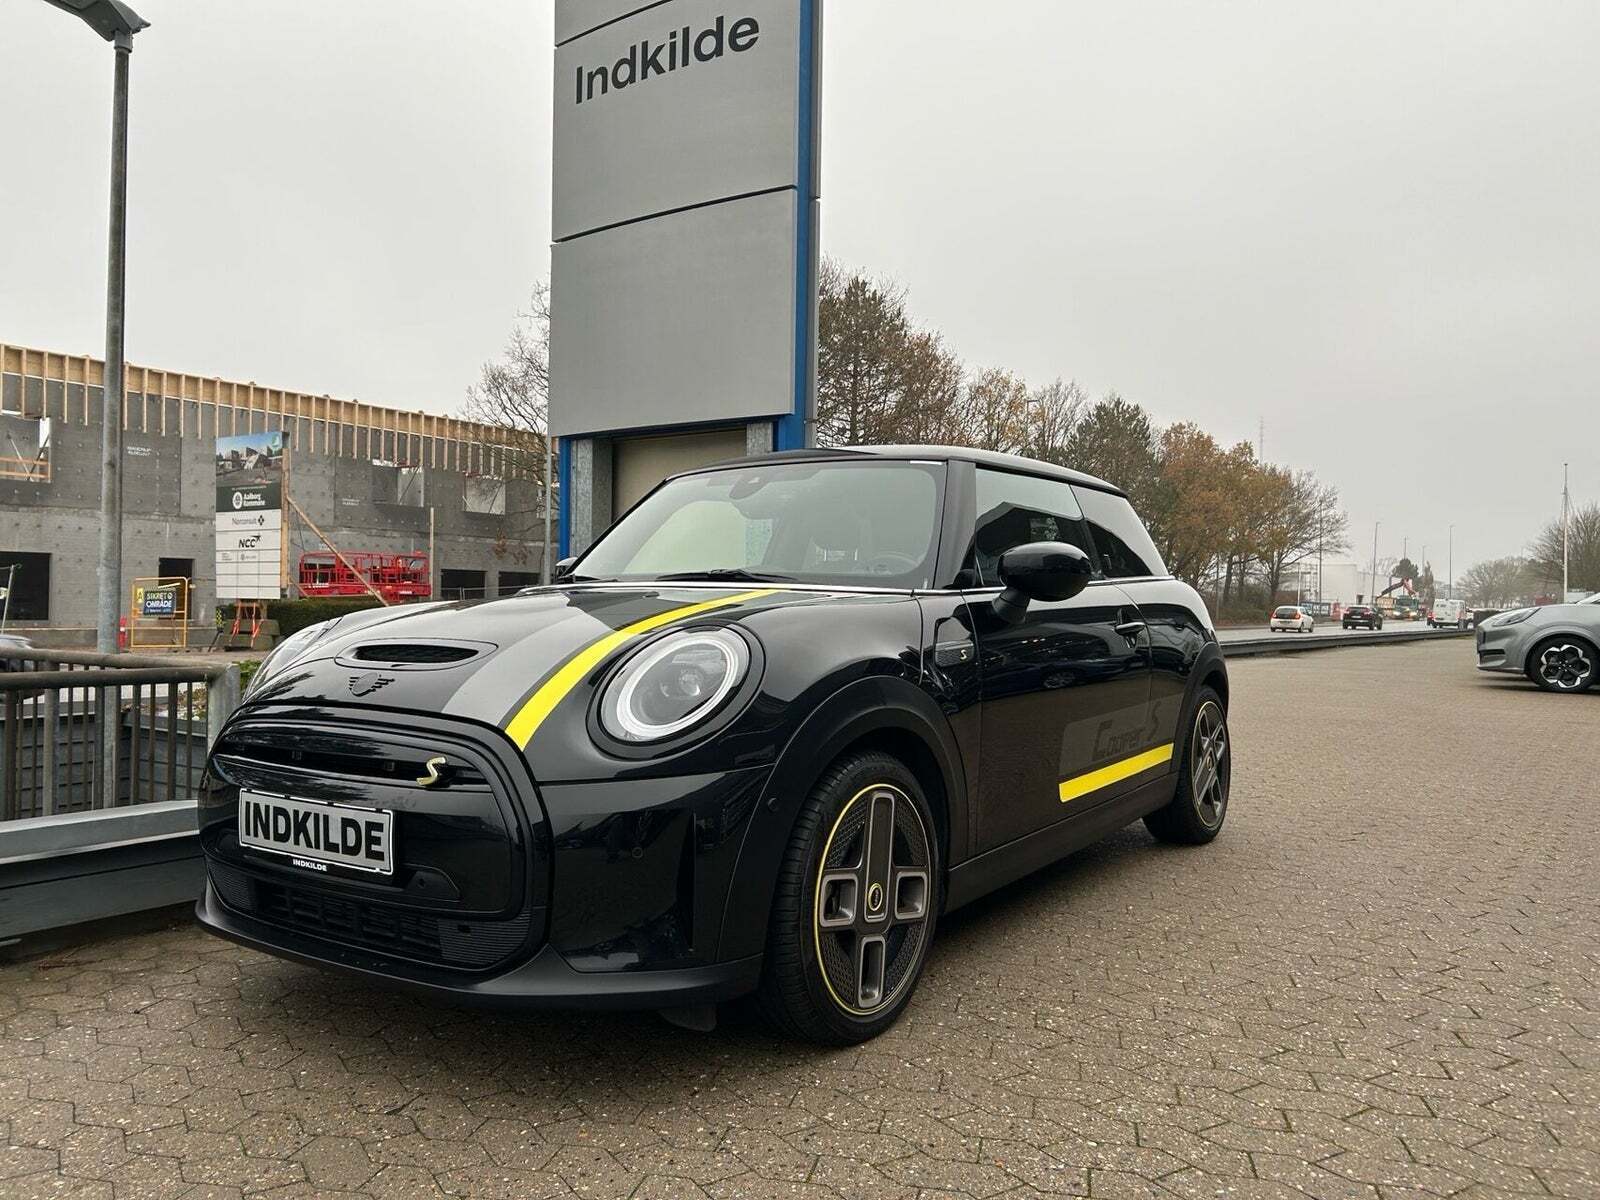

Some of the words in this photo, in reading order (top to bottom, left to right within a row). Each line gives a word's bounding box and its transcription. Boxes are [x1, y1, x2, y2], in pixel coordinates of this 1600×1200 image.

[576, 15, 759, 104] Indkilde
[238, 539, 256, 548] NCC
[960, 649, 967, 660] S
[416, 756, 446, 785] S
[244, 801, 385, 862] INDKILDE
[292, 858, 328, 872] INDKILDE
